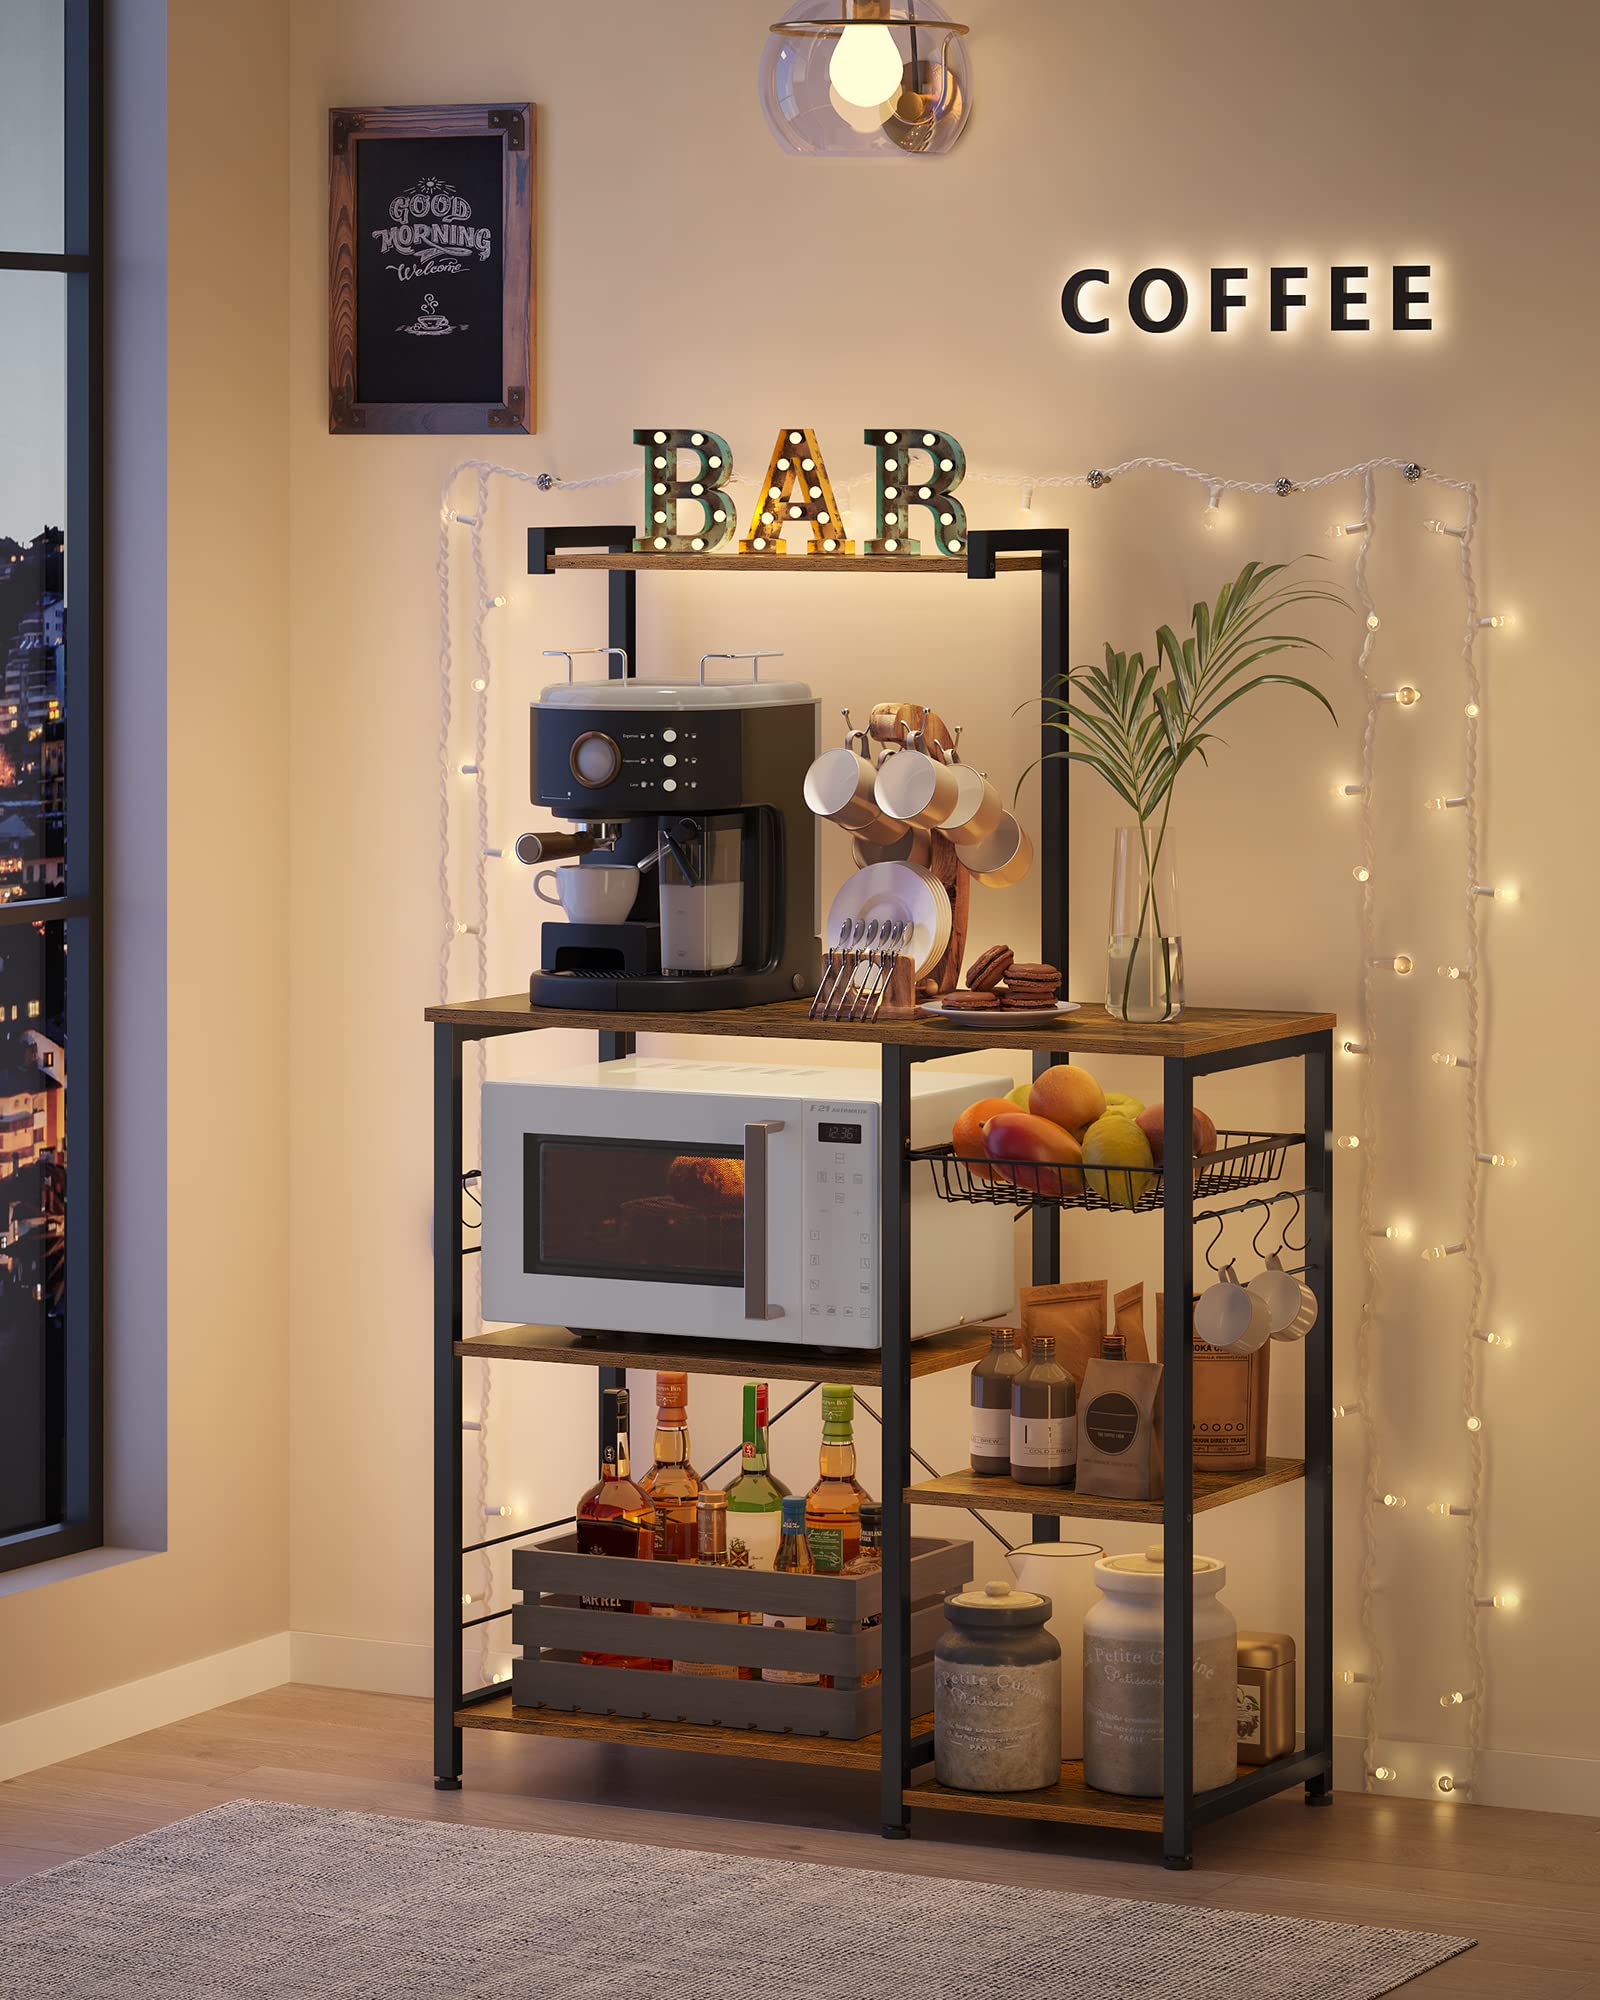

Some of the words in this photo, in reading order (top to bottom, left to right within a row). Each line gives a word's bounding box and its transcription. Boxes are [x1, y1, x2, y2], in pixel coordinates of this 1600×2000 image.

[389, 194, 472, 225] GOOD
[371, 223, 491, 262] MORNING
[385, 258, 471, 281] Welcome
[1061, 265, 1433, 334] COFFEE
[633, 428, 968, 556] BAR
[1095, 1647, 1142, 1665] Petite
